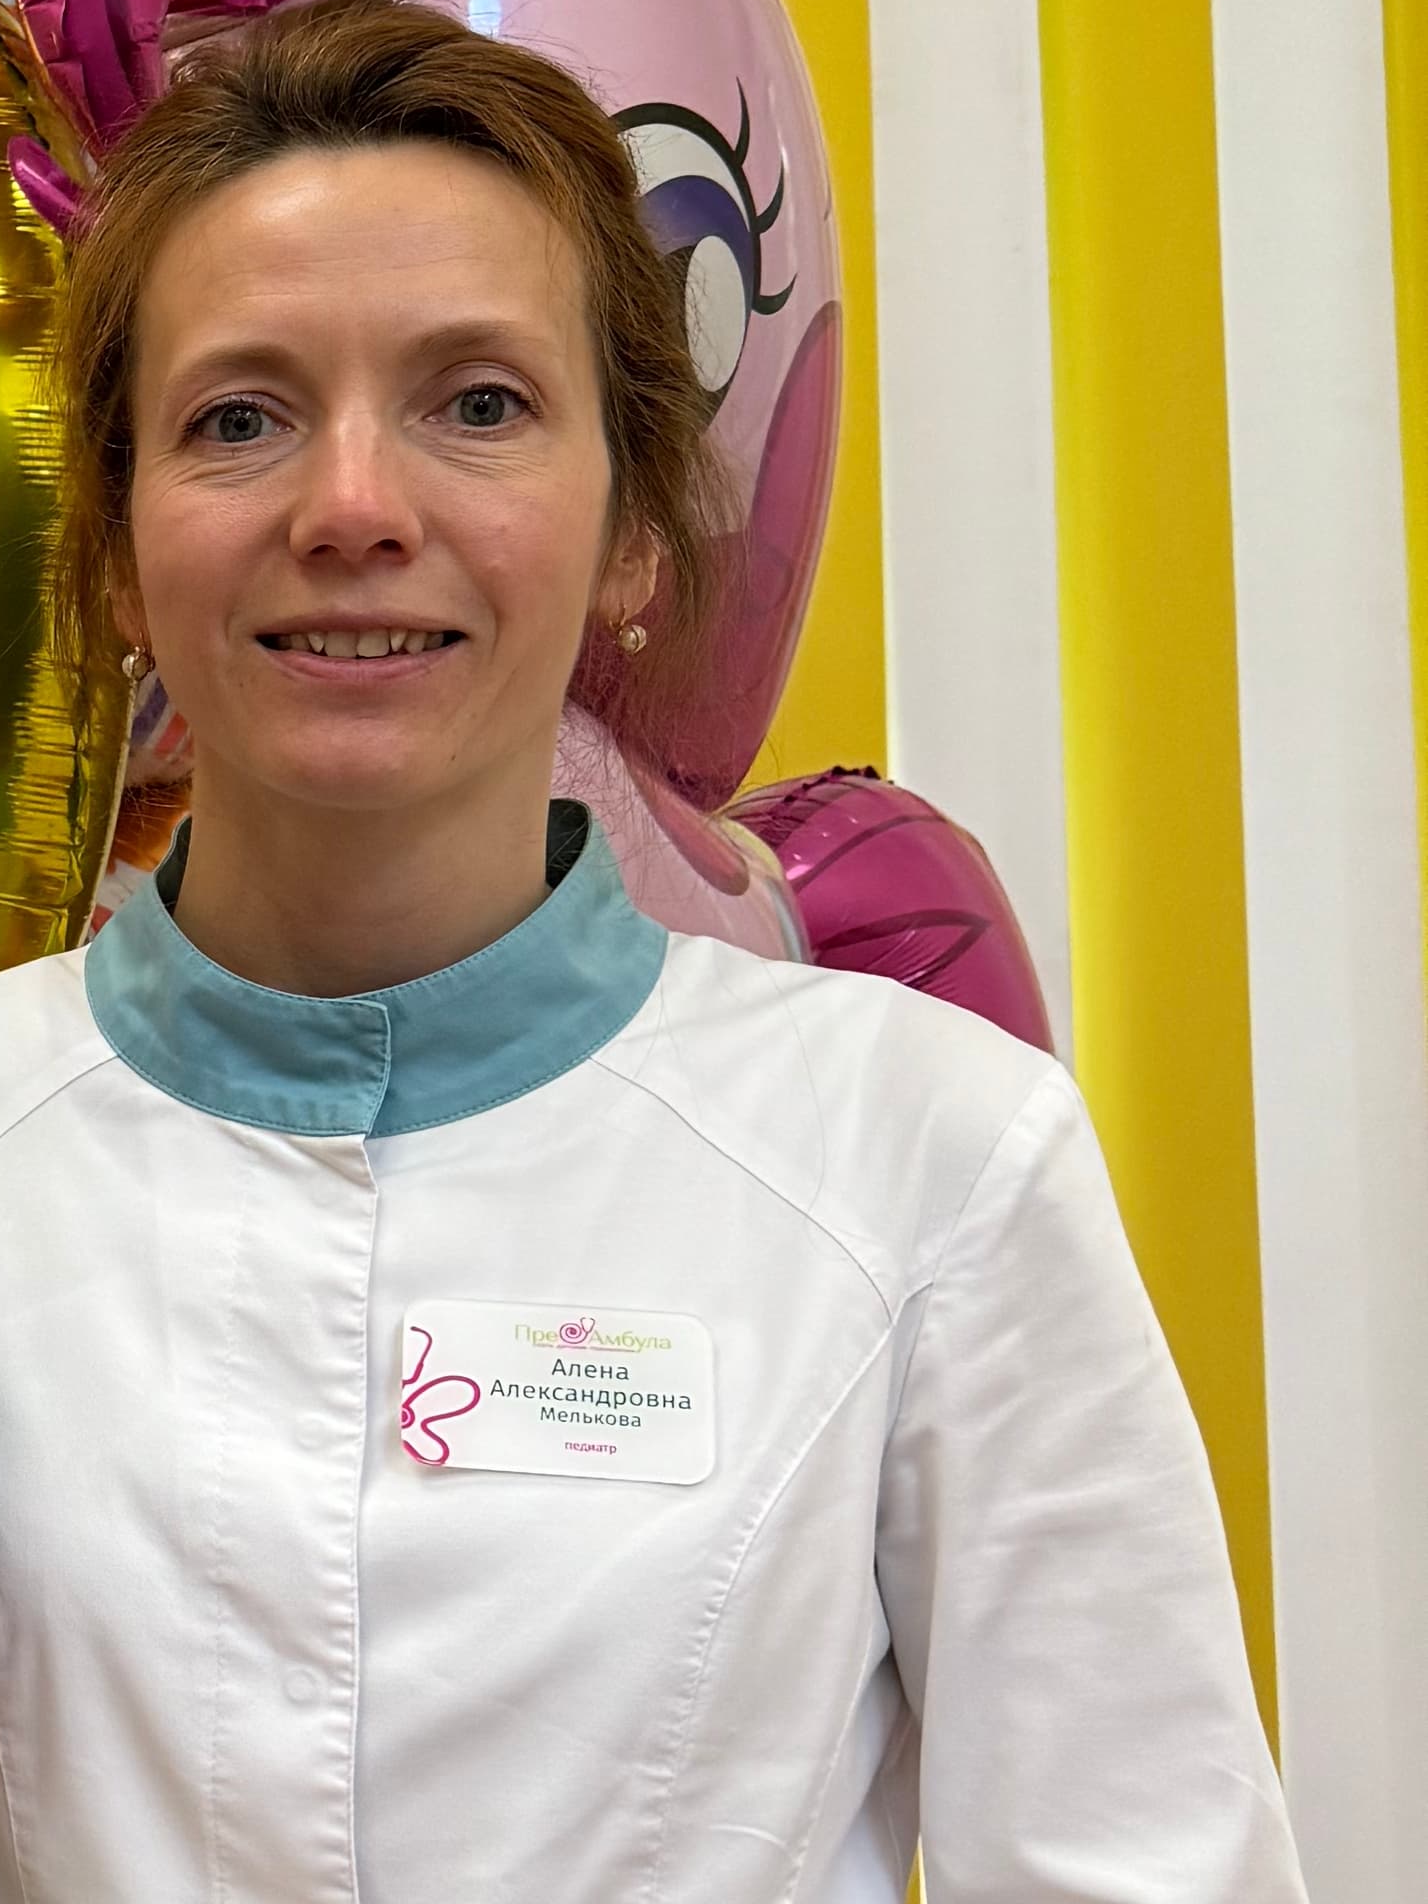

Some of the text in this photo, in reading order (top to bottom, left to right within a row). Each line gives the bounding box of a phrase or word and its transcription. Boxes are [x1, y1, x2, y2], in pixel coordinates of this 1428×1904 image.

[550, 1358, 631, 1381] Алена
[489, 1379, 693, 1410] Александровна
[539, 1406, 642, 1428] Мелькова
[564, 1440, 618, 1455] педиатр
